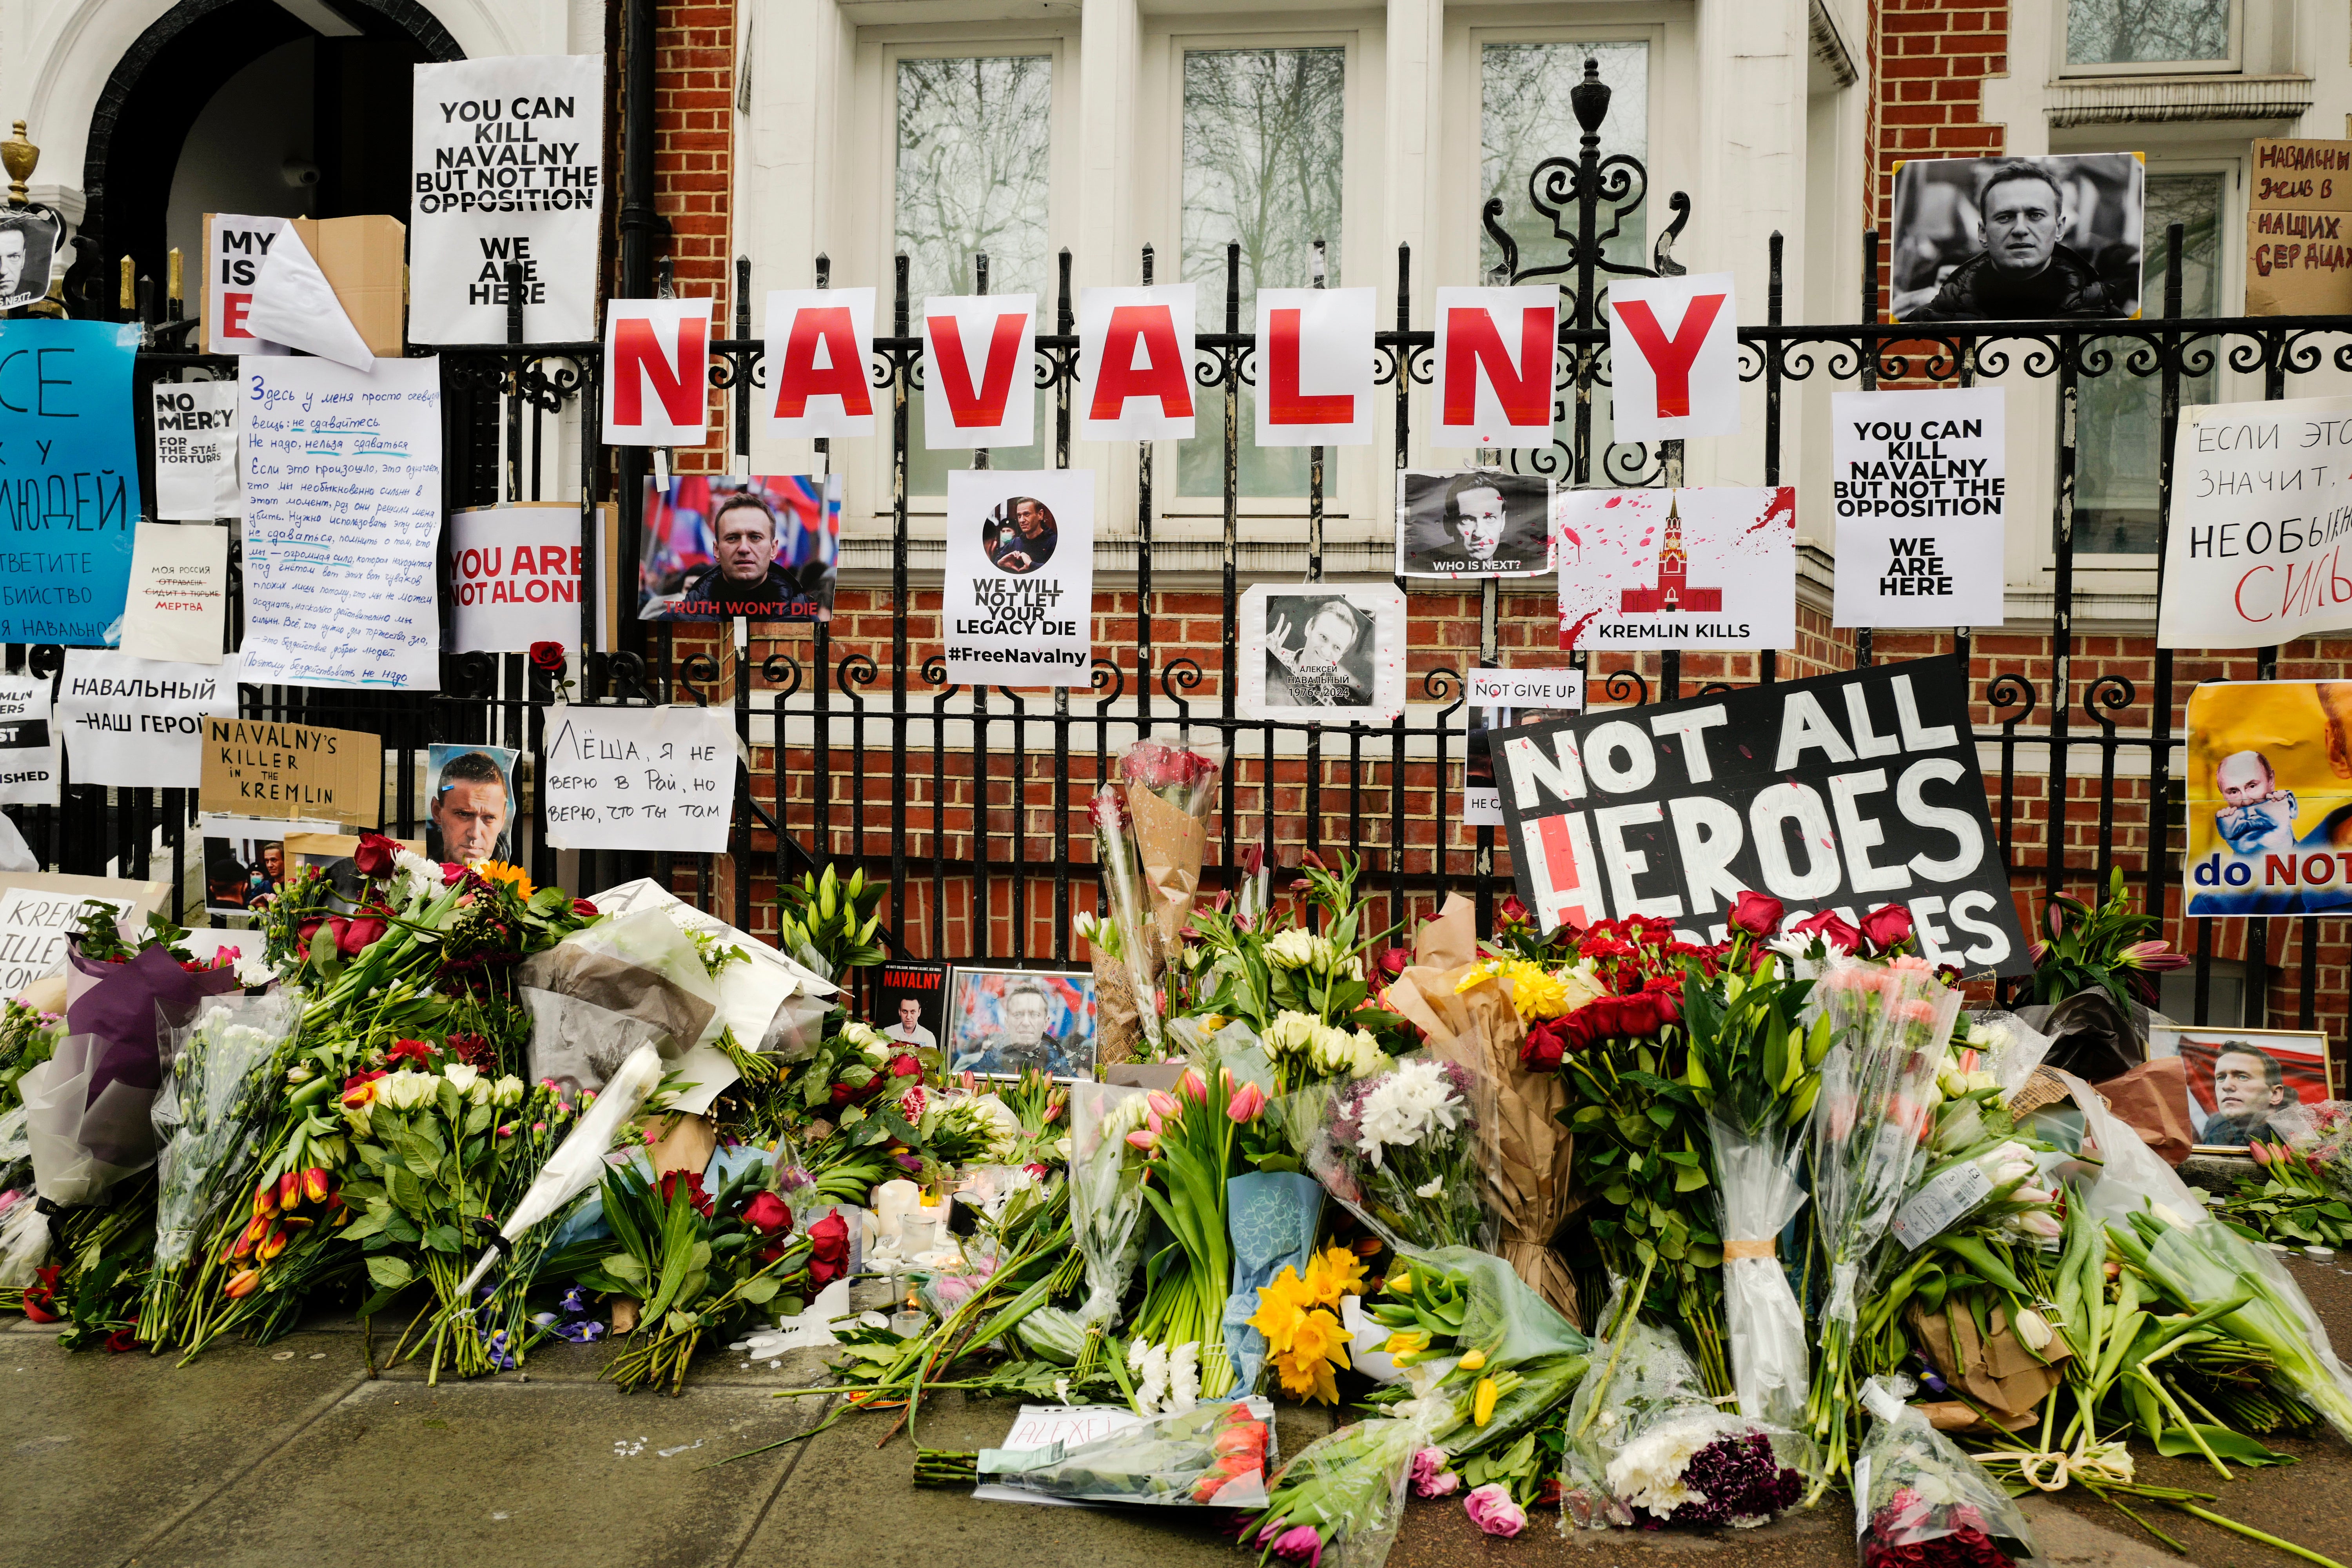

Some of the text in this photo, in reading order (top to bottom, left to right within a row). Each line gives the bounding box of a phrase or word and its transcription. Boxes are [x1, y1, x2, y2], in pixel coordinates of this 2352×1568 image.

[440, 96, 574, 123] YOU CAN
[475, 121, 538, 144] KILL
[436, 142, 580, 170] NAVALNY
[416, 165, 598, 193] BUT NOT THE
[419, 188, 593, 214] OPPOSITION
[222, 230, 276, 256] MY
[479, 237, 530, 260] WE
[222, 259, 256, 286] IS
[5, 291, 31, 305] NEXT?
[613, 293, 1727, 428] NAVALNY
[156, 393, 194, 412] NO
[250, 375, 295, 410] Здесь
[302, 390, 314, 412] у
[321, 392, 354, 404] меня
[362, 392, 401, 407] просто
[157, 409, 234, 431] MERCY
[252, 415, 380, 433] вещь: не сдавайтесь.
[1853, 419, 1982, 441] YOU CAN
[159, 437, 187, 446] FOR
[159, 446, 186, 455] THE
[249, 433, 408, 454] Не надо, нельзя сдаваться
[1888, 441, 1947, 460] KILL
[251, 457, 279, 475] Если
[287, 464, 310, 474] это
[316, 463, 377, 478] произошло,
[382, 463, 401, 473] это
[1851, 458, 1987, 480] NAVALNY
[1834, 478, 2005, 499] BUT NOT THE
[1837, 497, 2001, 517] OPPOSITION
[1889, 537, 1935, 557] WE
[179, 566, 211, 575] РОССИЯ
[450, 546, 582, 581] YOU ARE
[1432, 560, 1522, 571] WHO IS NEXT?
[1887, 557, 1944, 576] ARE
[450, 579, 582, 607] NOT ALON
[973, 578, 1063, 593] WE WILL
[1880, 577, 1953, 596] HERE
[154, 601, 203, 612] МЕРТВА
[663, 600, 720, 614] TRUTH
[791, 602, 817, 615] DIE
[975, 592, 1060, 607] NOT LET
[987, 606, 1045, 621] YOUR
[22, 619, 114, 637] НАВАЛЬНО
[956, 619, 1076, 636] LEGACY DIE
[1599, 624, 1750, 638] KREMLIN KILLS
[948, 647, 1087, 668] #FreeNavalny
[72, 678, 216, 700] НАВАЛЬНЫЙ
[1287, 675, 1350, 684] НАВАЛЬНЫЙ
[1288, 688, 1314, 697] 1976
[1323, 688, 1350, 697] 2024
[1476, 684, 1575, 698] NOT GIVE UP
[212, 721, 337, 754] NAVALNY'S
[1504, 673, 1960, 809] NOT ALL
[221, 747, 298, 770] KILLER
[660, 743, 673, 760] Я
[690, 746, 716, 761] НЕ
[261, 771, 279, 780] THE
[548, 775, 597, 790] ВЕРЮ
[614, 775, 630, 789] В
[694, 778, 715, 791] НО
[241, 781, 332, 804] KREMLIN
[1472, 799, 1486, 809] НЕ
[1521, 757, 1984, 936] HEROES
[2194, 853, 2252, 886] do
[883, 971, 942, 990] NAVALNY
[1967, 1167, 1980, 1180] £3
